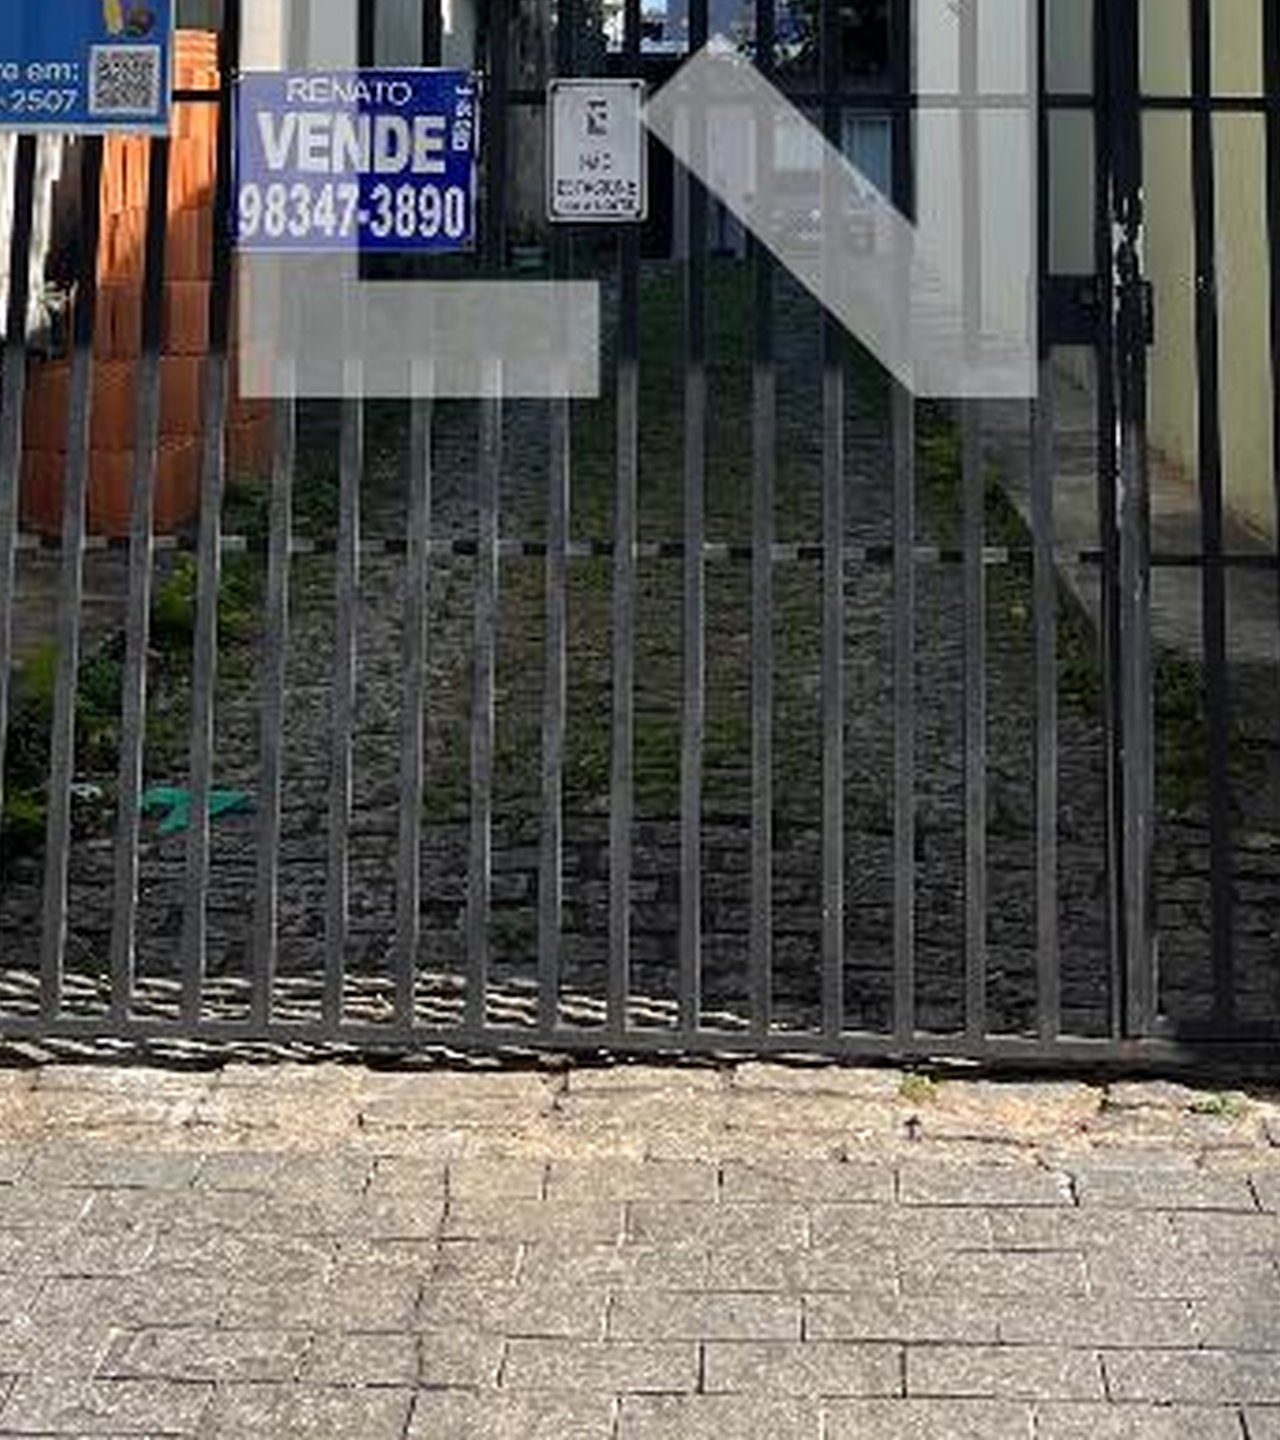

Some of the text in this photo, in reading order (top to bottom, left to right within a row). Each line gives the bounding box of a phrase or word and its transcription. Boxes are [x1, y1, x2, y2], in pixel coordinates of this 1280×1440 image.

[26, 63, 80, 83] em:
[286, 79, 412, 105] RENATO
[258, 111, 447, 174] VENDE
[238, 184, 466, 238] 98347-3890
